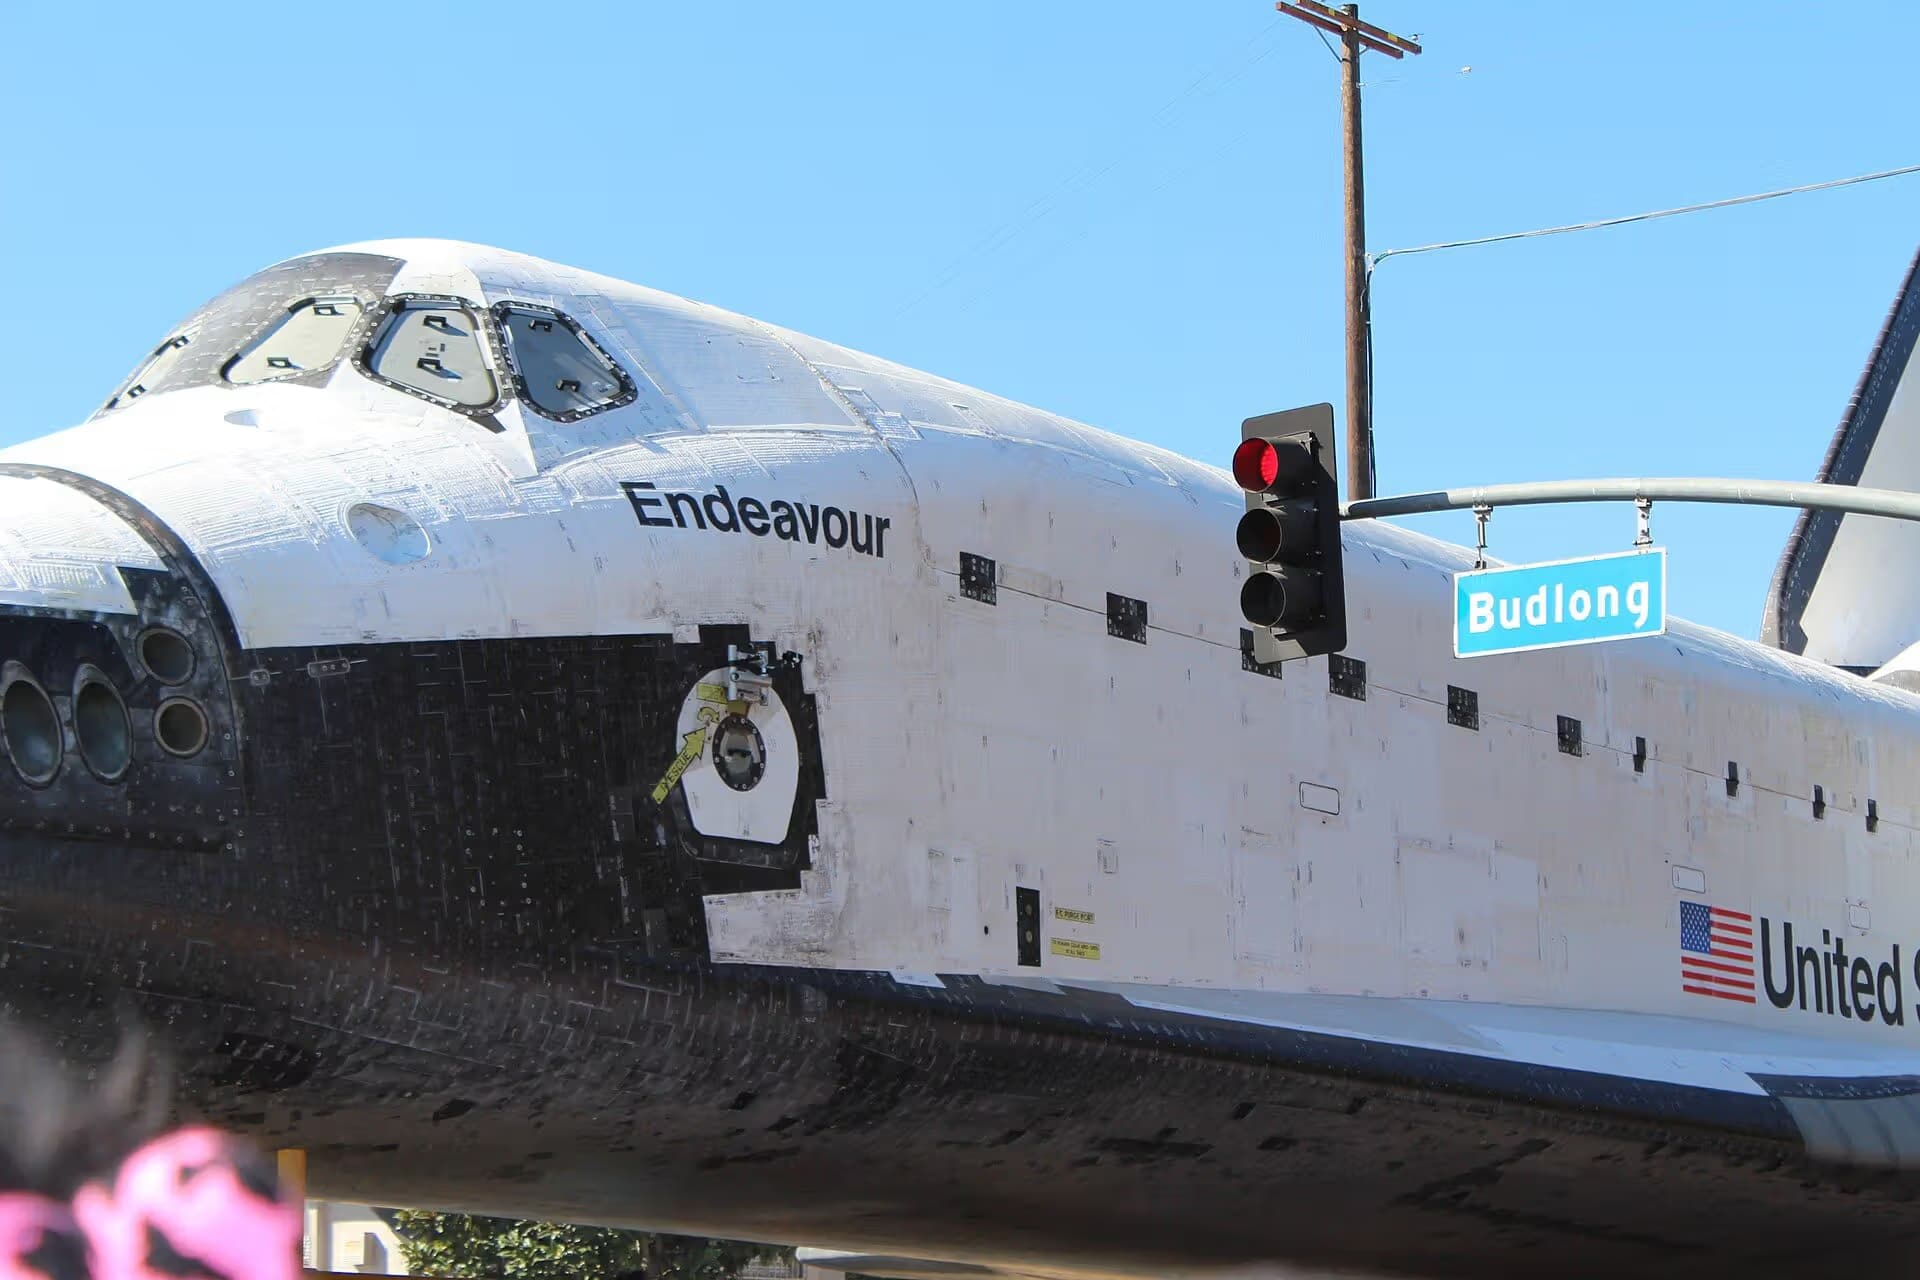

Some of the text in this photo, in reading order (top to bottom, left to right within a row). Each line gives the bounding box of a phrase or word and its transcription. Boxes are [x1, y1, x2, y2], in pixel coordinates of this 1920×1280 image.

[619, 481, 891, 558] Endeavour
[1469, 581, 1649, 633] Budlong
[1761, 917, 1904, 1026] United
